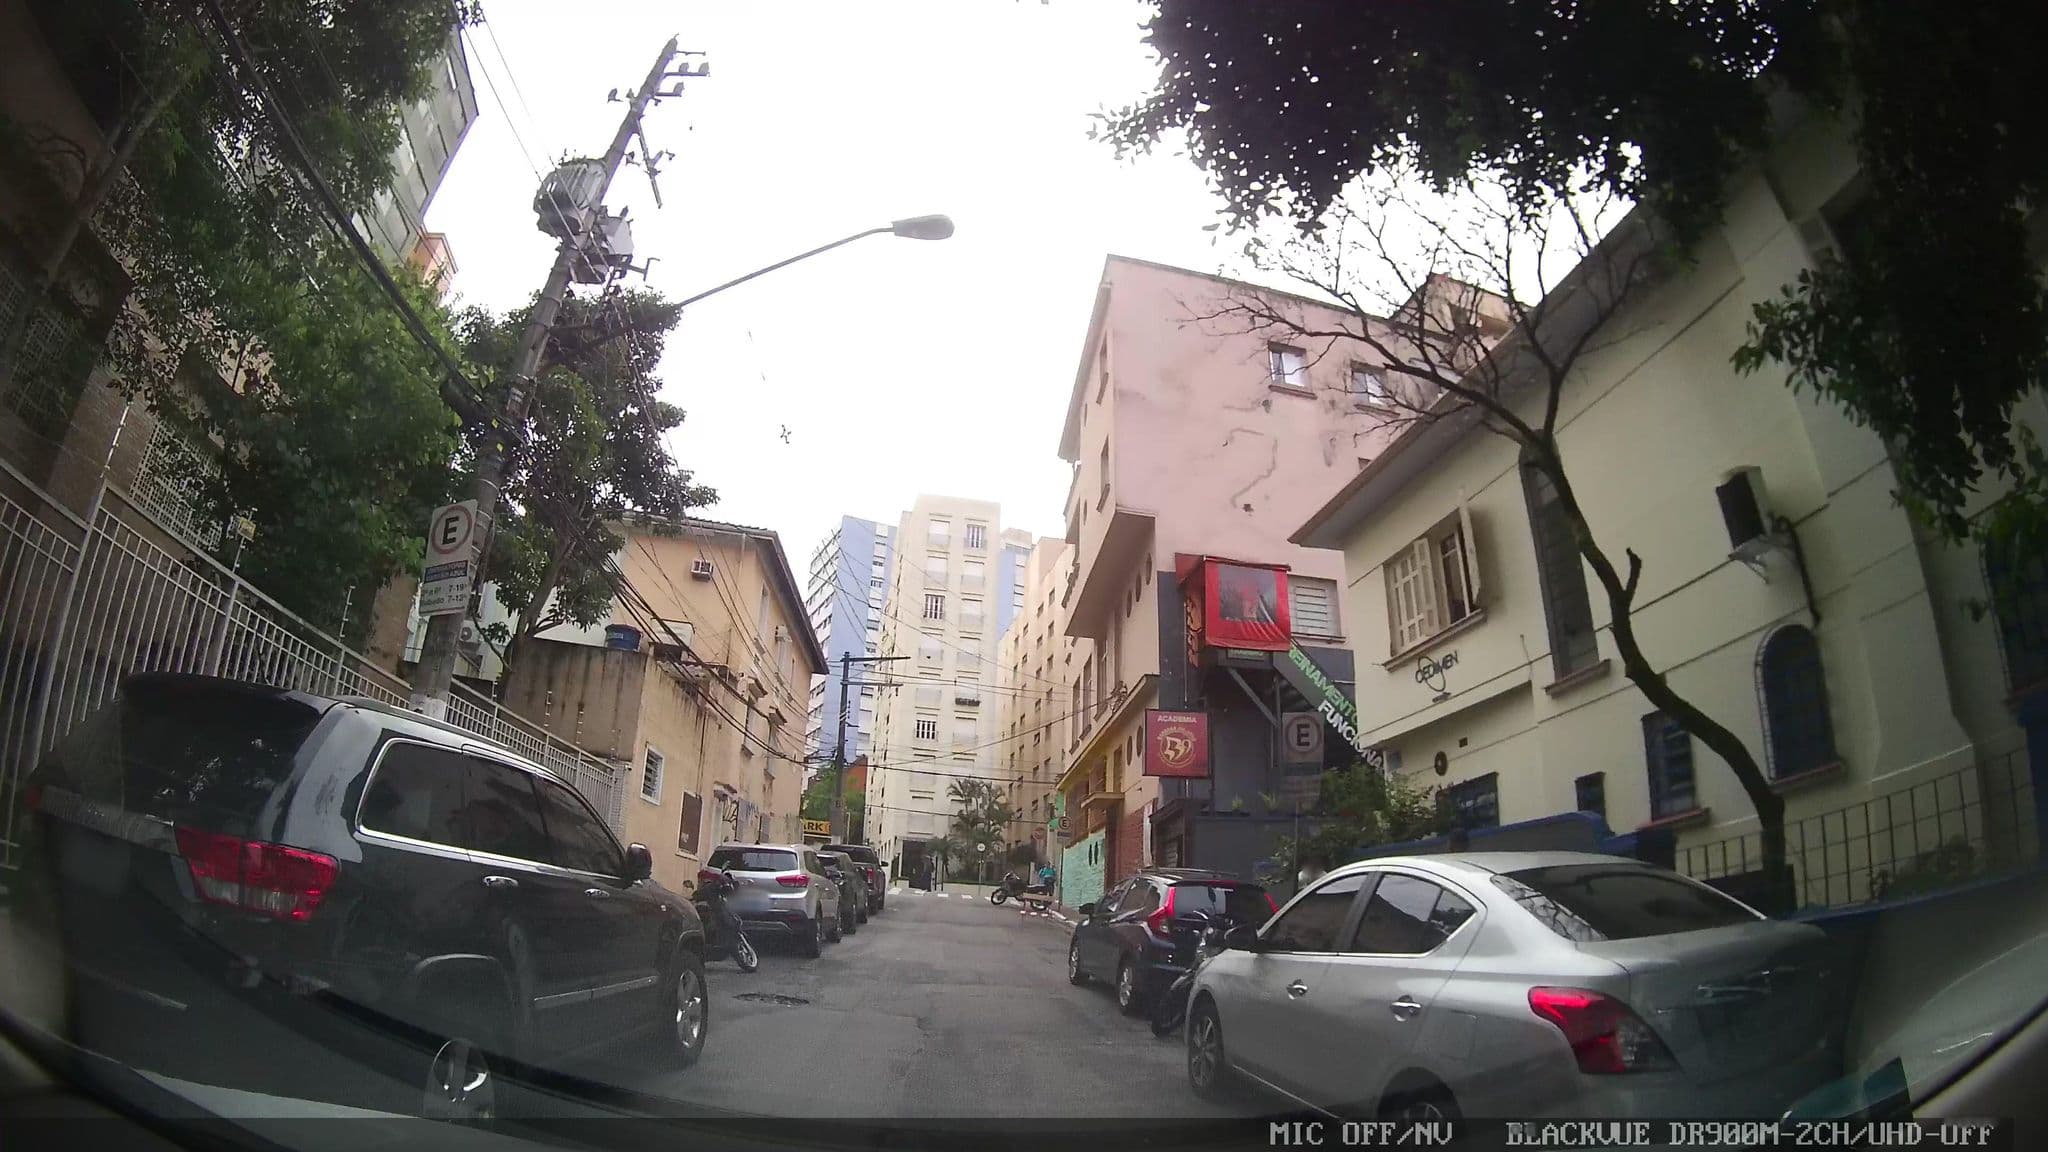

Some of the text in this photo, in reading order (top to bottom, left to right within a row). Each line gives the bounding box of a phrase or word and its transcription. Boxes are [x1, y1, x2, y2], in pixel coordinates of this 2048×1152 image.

[443, 516, 459, 545] E
[1157, 714, 1197, 723] ACADEMIA
[1297, 723, 1310, 747] E
